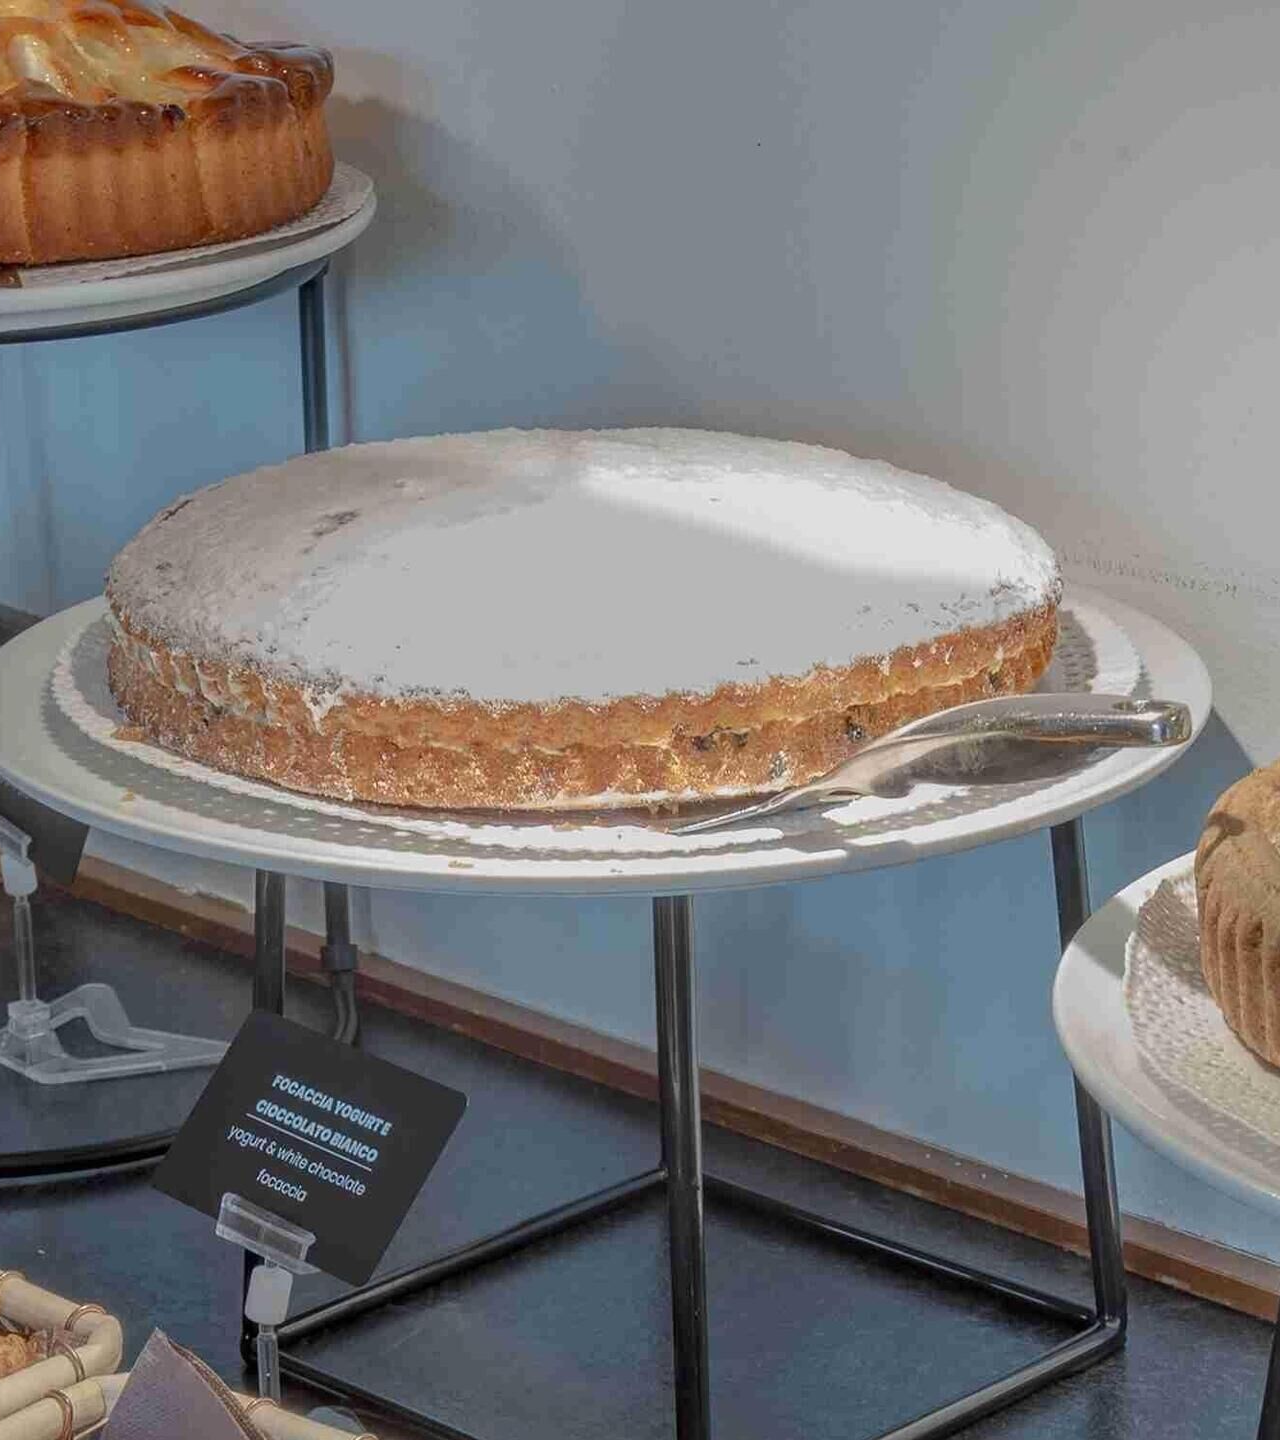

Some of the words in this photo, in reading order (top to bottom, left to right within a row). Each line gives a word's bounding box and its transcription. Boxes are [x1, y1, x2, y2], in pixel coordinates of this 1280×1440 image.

[256, 1099, 330, 1143] CIOCCOLATO
[329, 1130, 378, 1162] BIANCO
[272, 1075, 334, 1112] FOCACCIA
[334, 1100, 383, 1133] YOGURT
[379, 1122, 392, 1136] E
[227, 1125, 265, 1152] yogurt
[266, 1141, 277, 1155] &
[277, 1148, 307, 1169] white
[308, 1162, 366, 1195] chocolate
[256, 1168, 307, 1202] focaccia
